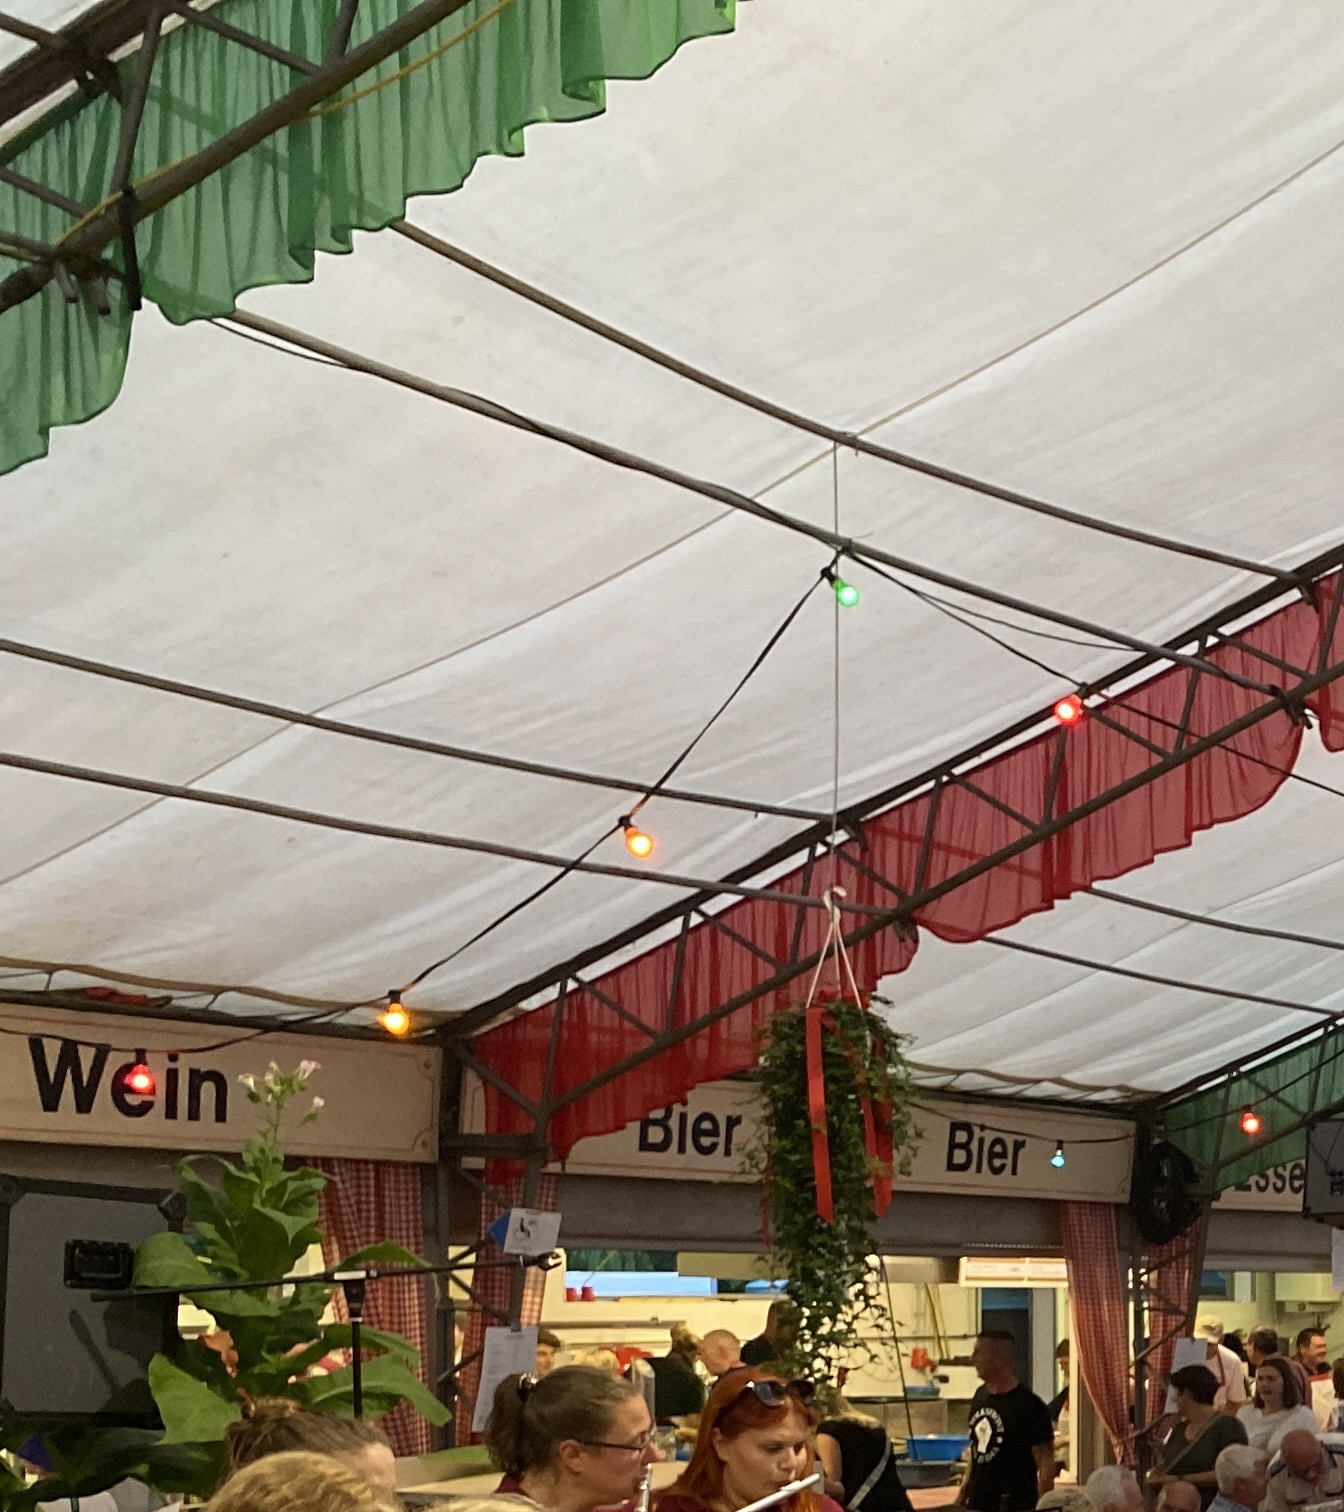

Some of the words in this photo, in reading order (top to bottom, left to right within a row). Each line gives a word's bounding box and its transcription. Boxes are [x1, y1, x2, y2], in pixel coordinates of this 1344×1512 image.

[28, 1034, 228, 1123] Wein
[638, 1103, 743, 1158] Bier
[946, 1121, 1026, 1177] Bier
